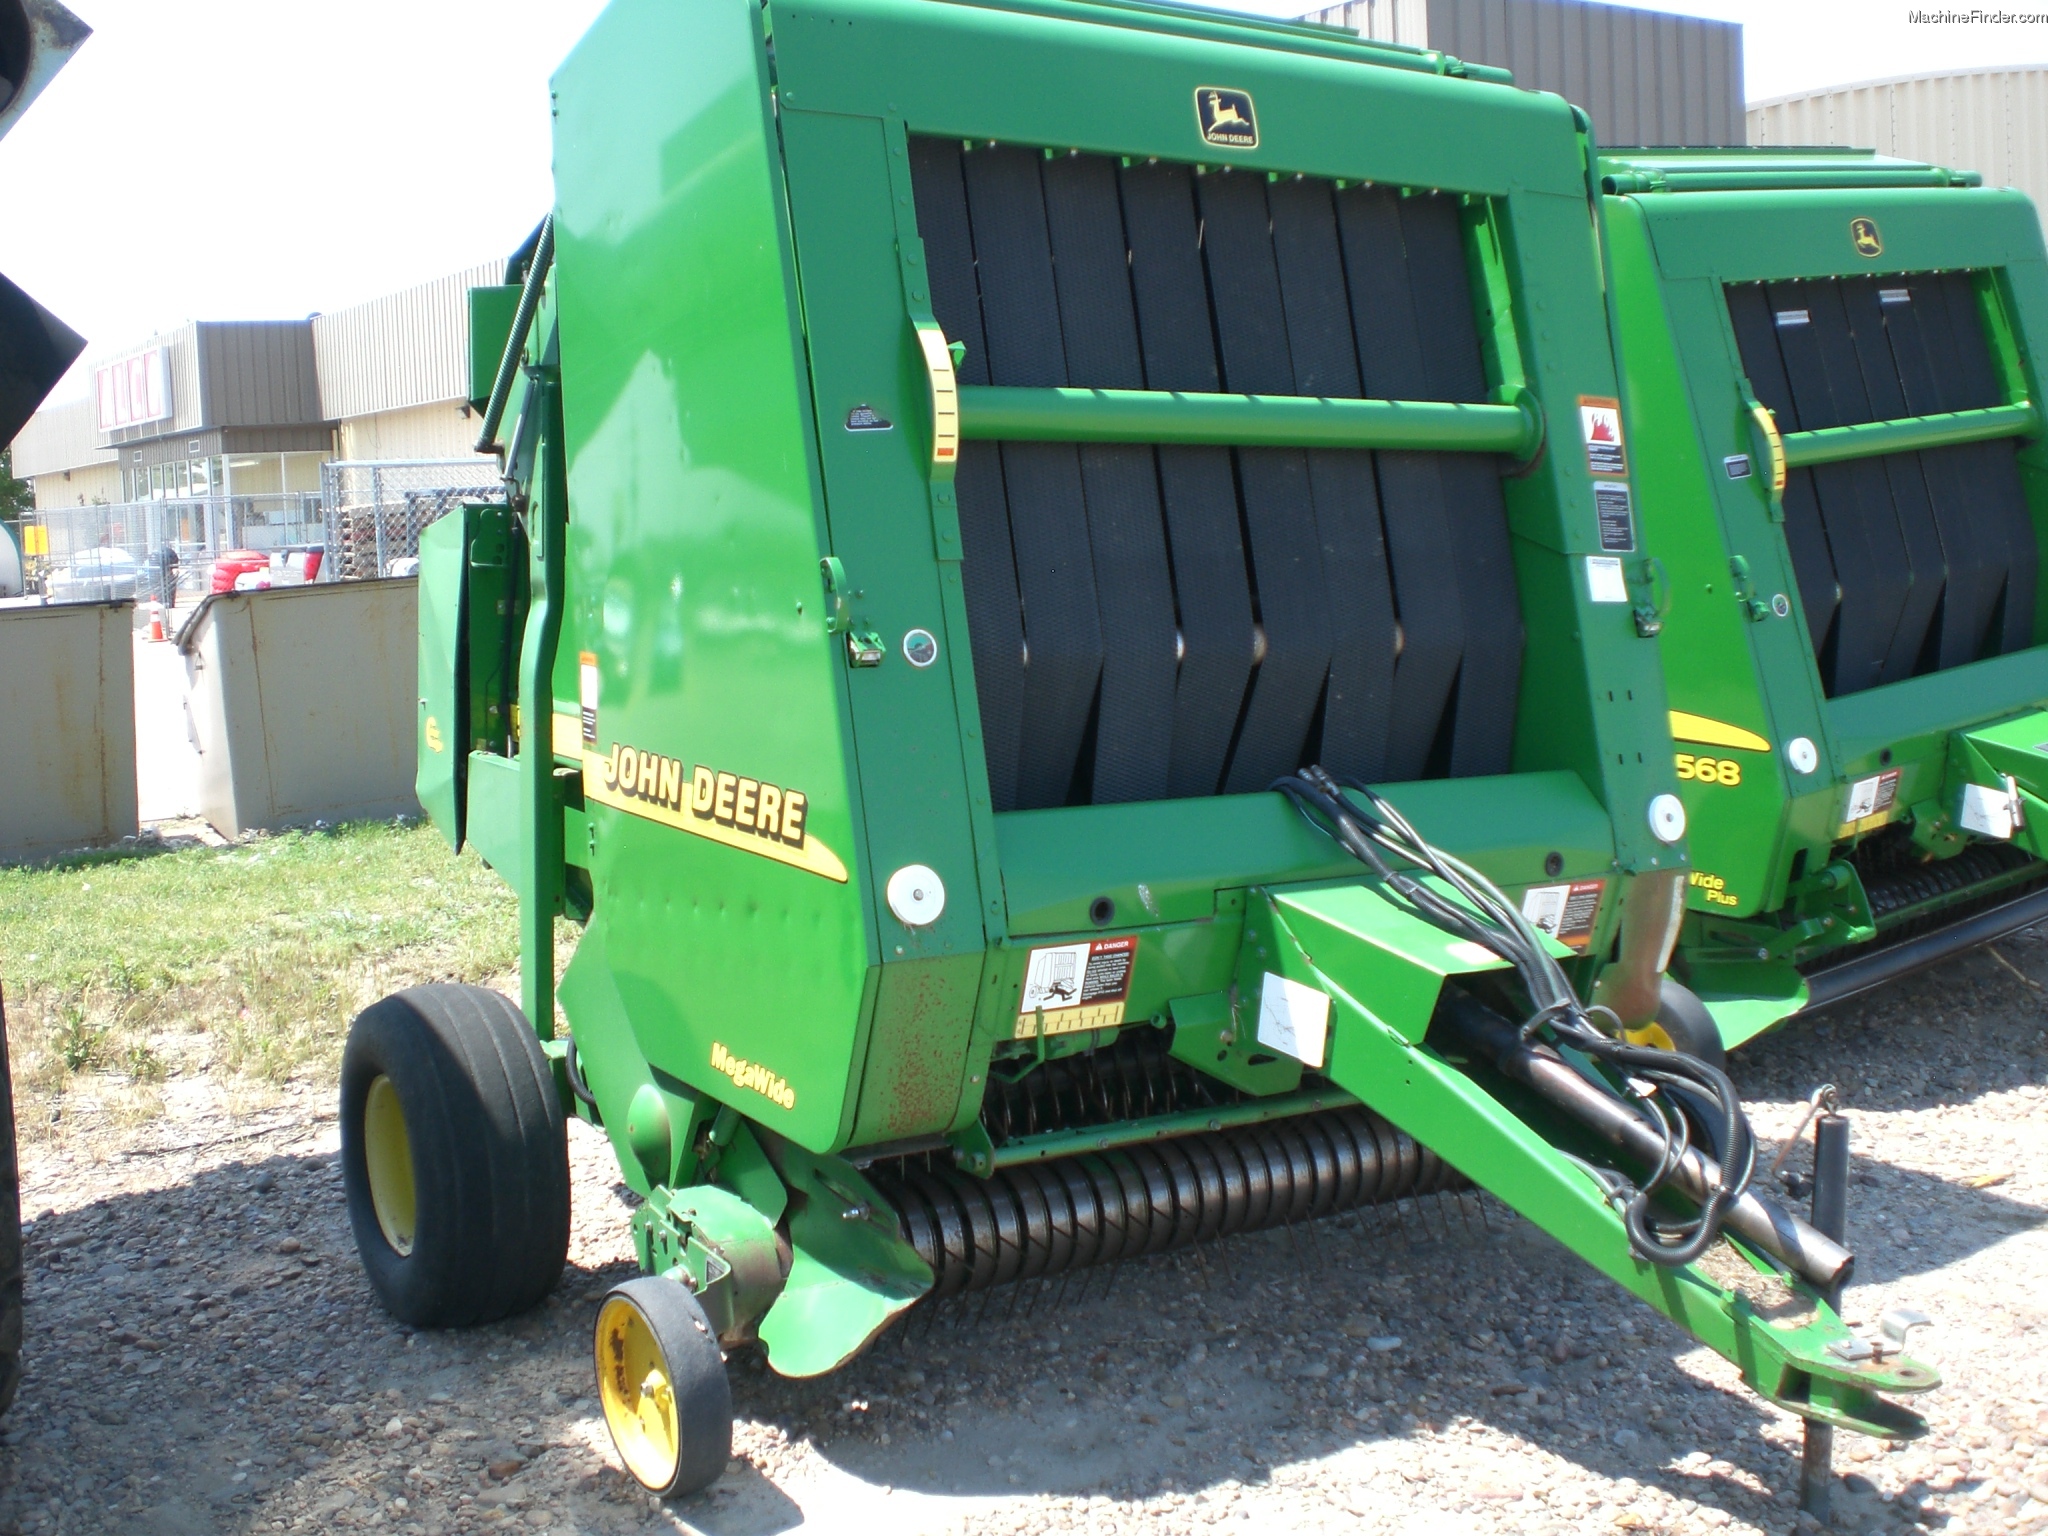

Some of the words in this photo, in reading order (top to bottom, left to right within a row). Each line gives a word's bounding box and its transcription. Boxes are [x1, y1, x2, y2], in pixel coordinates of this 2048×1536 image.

[1207, 132, 1228, 142] JOHN
[1229, 134, 1254, 144] DEERE
[1675, 752, 1741, 787] 568
[604, 742, 684, 812] JOHN
[692, 764, 809, 850] DEERE
[1706, 889, 1739, 906] Plus
[1103, 940, 1130, 950] DANGER
[710, 1040, 796, 1111] MegaWide
